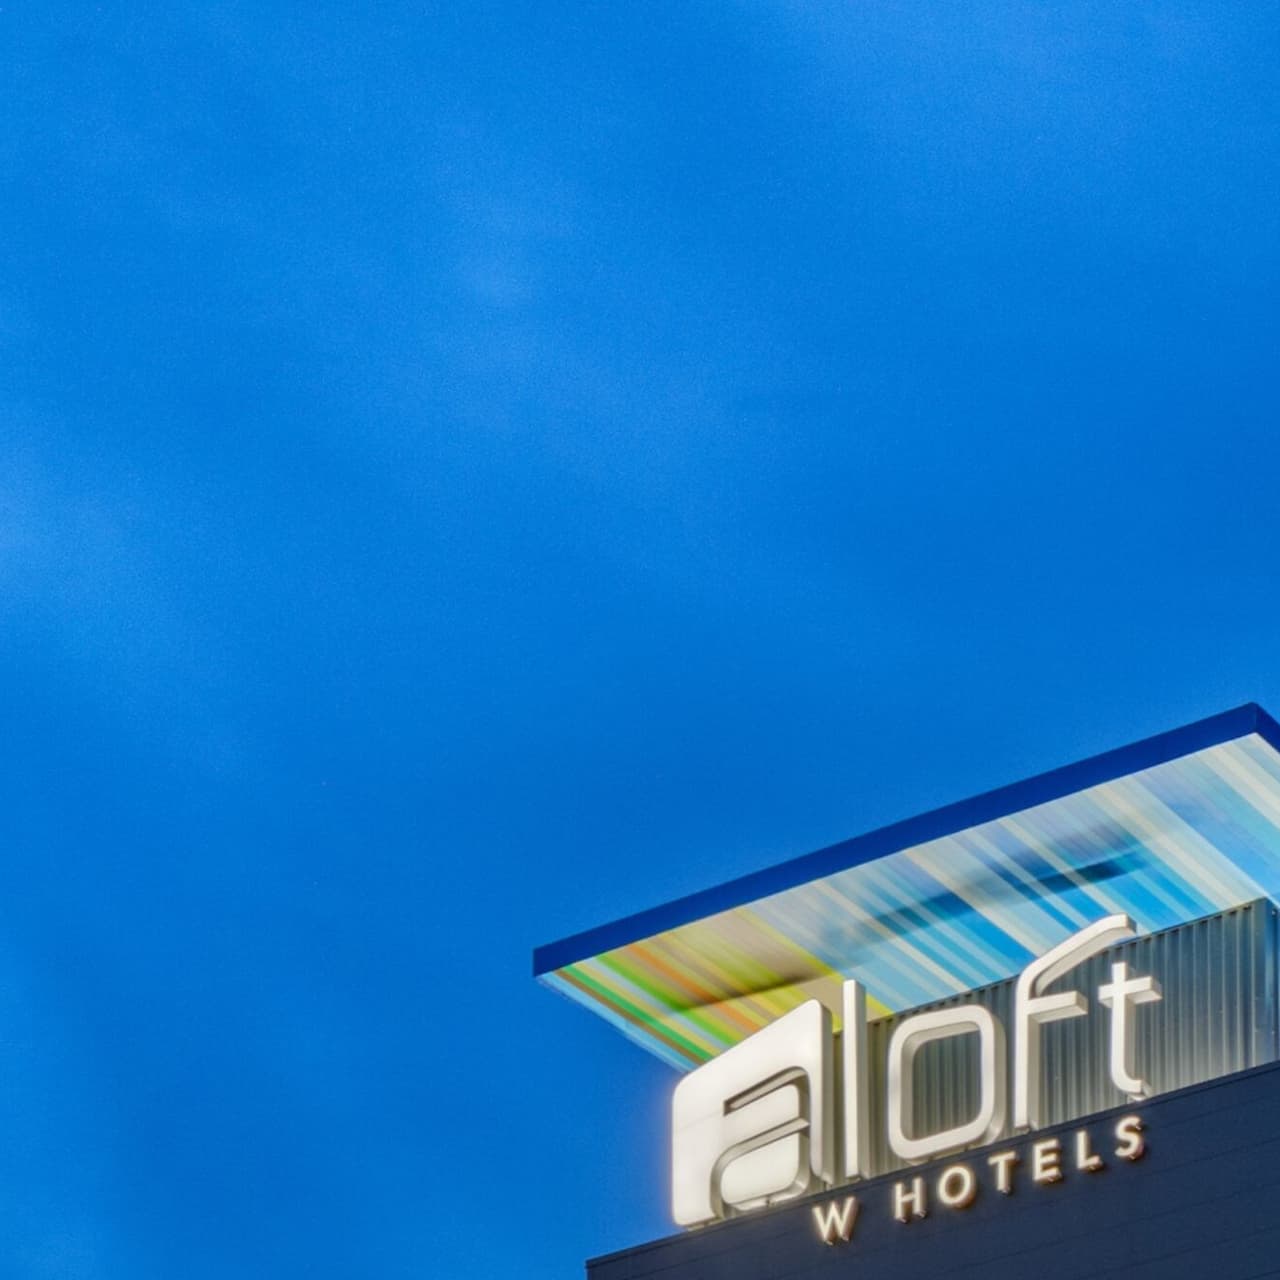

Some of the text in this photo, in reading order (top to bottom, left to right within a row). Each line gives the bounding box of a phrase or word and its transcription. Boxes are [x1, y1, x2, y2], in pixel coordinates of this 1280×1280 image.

[672, 913, 1161, 1228] aloft
[813, 1115, 1145, 1245] W HOTELS
